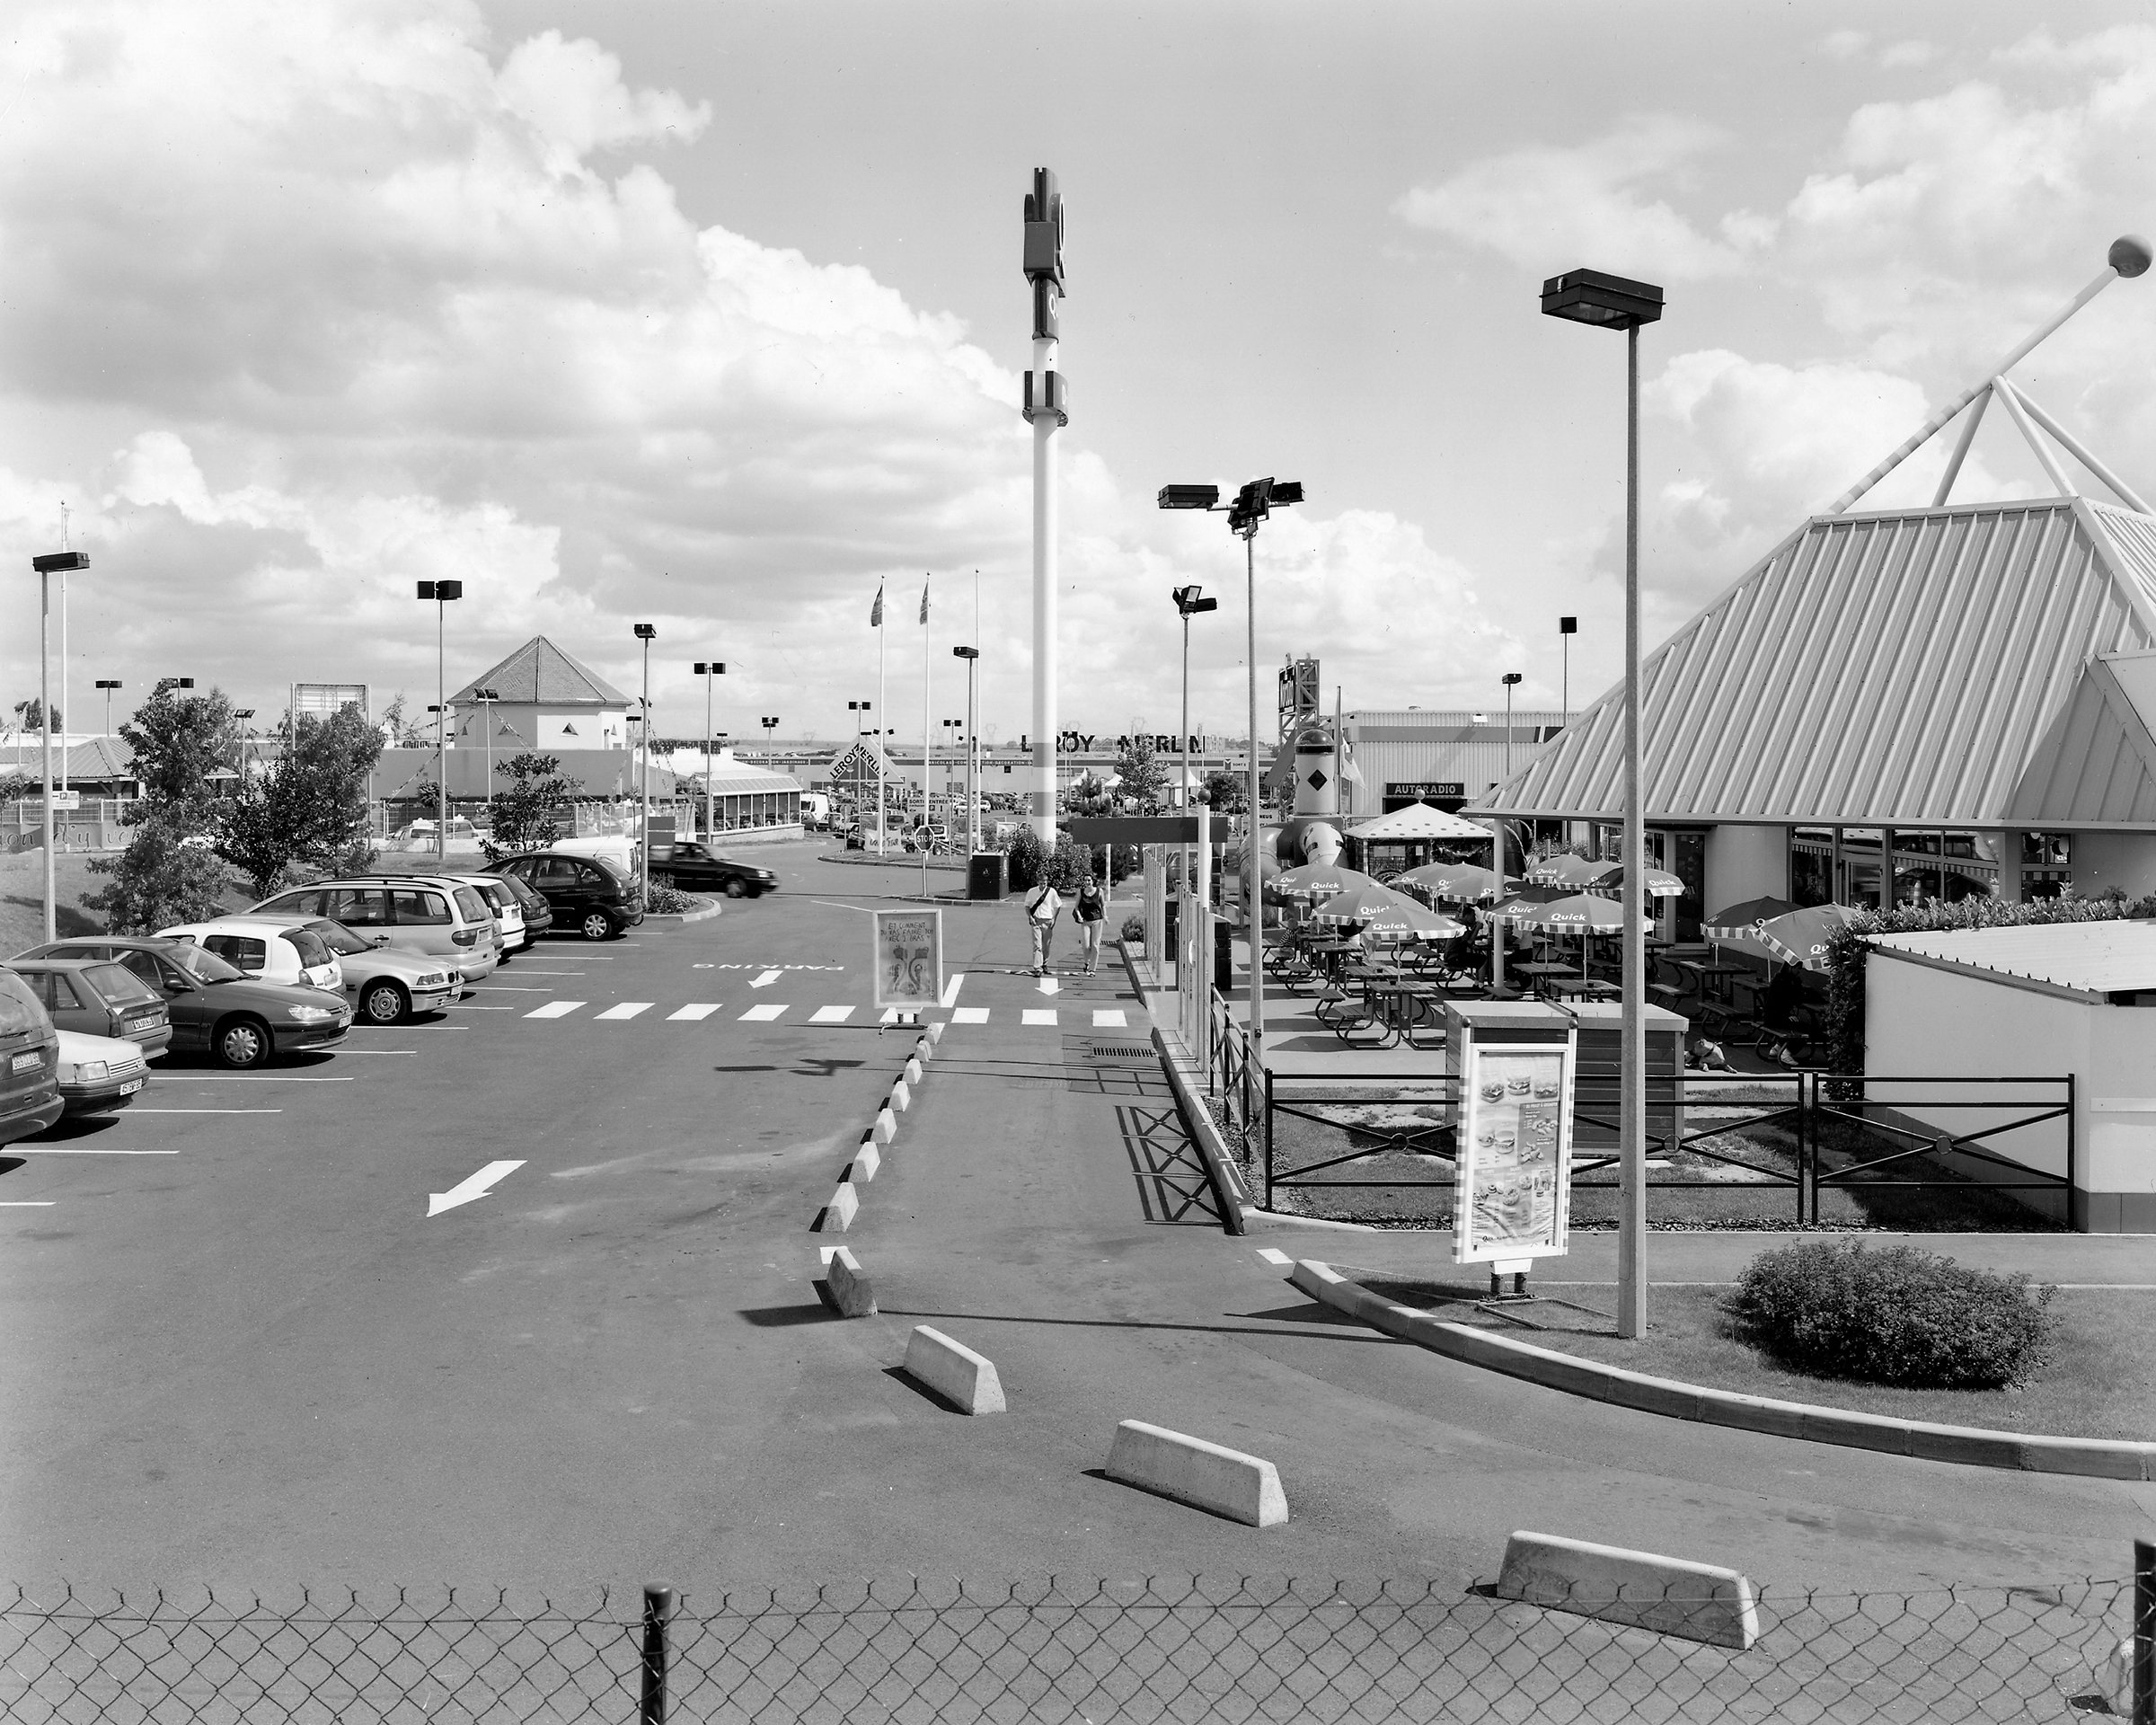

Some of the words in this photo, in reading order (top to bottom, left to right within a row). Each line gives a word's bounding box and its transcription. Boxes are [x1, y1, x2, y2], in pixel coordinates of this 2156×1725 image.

[1021, 734, 1095, 753] LROY
[1120, 734, 1205, 753] MRLN
[830, 748, 857, 779] LEROY
[917, 834, 932, 843] STOP
[1311, 881, 1339, 889] Quick
[1360, 906, 1390, 915] Quic
[1551, 913, 1586, 922] Quick
[899, 922, 925, 930] COMMENT
[1372, 923, 1409, 931] Quick
[692, 963, 845, 971] PARKING
